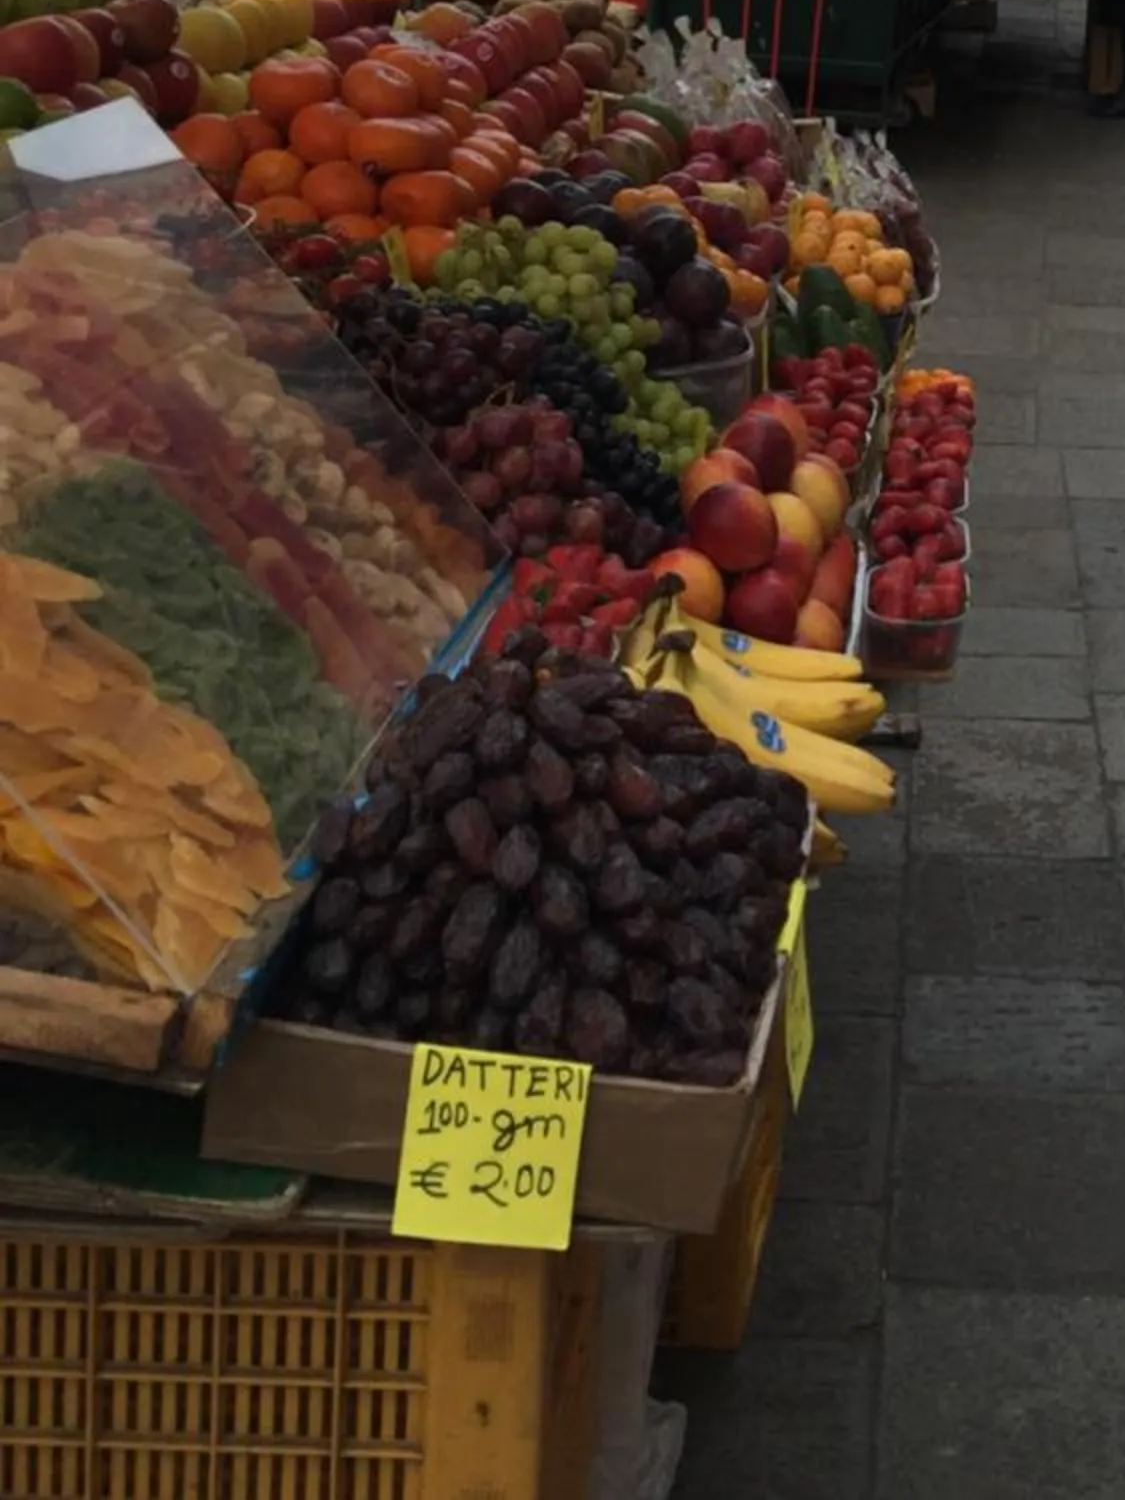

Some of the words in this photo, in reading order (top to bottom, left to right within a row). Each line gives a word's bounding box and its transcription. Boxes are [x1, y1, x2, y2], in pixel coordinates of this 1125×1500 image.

[421, 1048, 586, 1102] DATTERI
[492, 1108, 567, 1152] gm
[409, 1161, 450, 1199] €
[469, 1160, 556, 1208] 2.00
